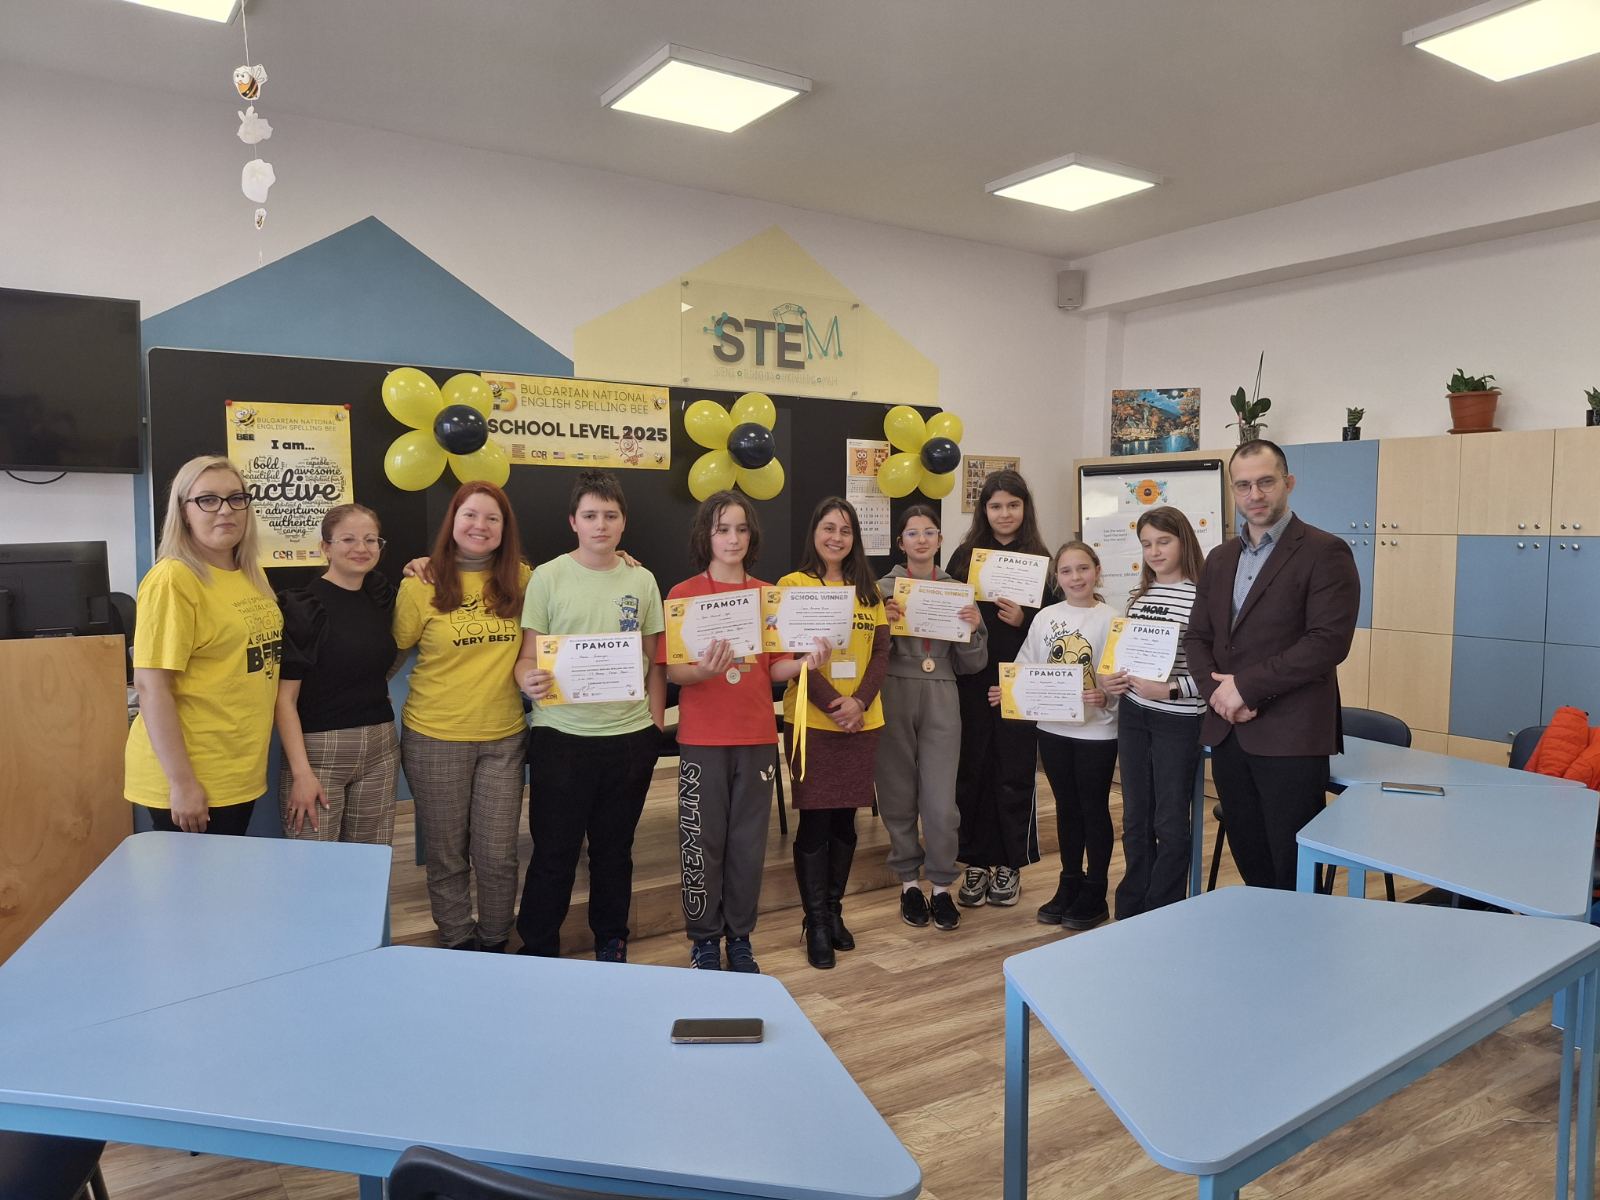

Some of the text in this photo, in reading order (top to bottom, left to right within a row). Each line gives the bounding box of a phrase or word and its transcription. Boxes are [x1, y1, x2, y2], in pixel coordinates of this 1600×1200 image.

[712, 315, 843, 369] STEM
[520, 384, 648, 403] BULGARIAN NATIONAL
[521, 396, 649, 414] ENGLISH SPELLING BEE
[257, 417, 336, 426] BULGARIAN NATIONAL
[487, 418, 667, 442] SCHOOL LEVEL 2025
[236, 433, 255, 441] BEE
[271, 440, 315, 450] I am...
[253, 457, 279, 470] bold
[241, 470, 280, 482] beautiful
[294, 468, 342, 476] awesome
[249, 468, 341, 501] active
[269, 515, 319, 527] authentic
[283, 528, 306, 537] caring
[999, 557, 1039, 567] ГРАМОТА
[701, 598, 749, 611] ГРАМОТА
[1140, 605, 1169, 615] MORE
[452, 620, 516, 637] YOUR
[1133, 626, 1170, 636] ГРАМОТА
[453, 634, 516, 646] VERY BEST
[575, 641, 630, 650] ГРАМОТА
